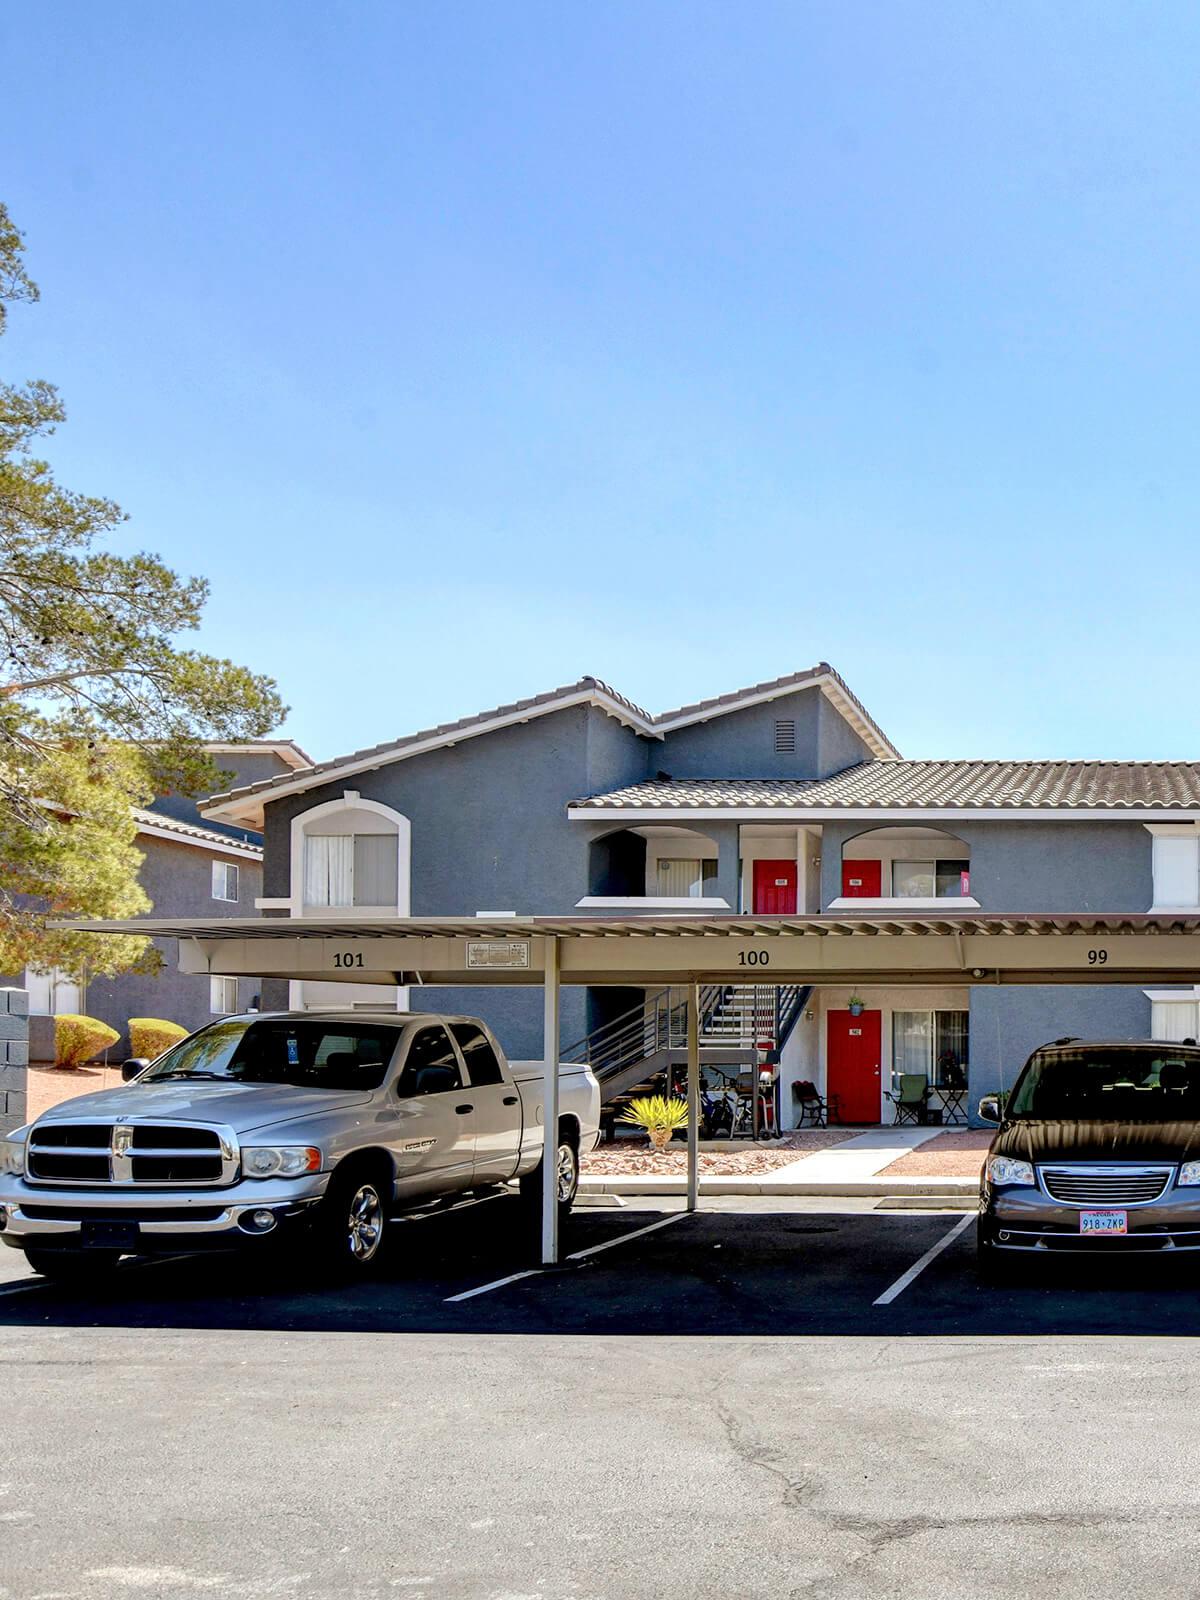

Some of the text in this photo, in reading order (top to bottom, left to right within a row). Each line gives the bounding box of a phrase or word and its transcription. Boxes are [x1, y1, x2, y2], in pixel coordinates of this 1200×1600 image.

[334, 953, 365, 968] 101
[738, 951, 769, 966] 100
[1087, 949, 1108, 965] 99
